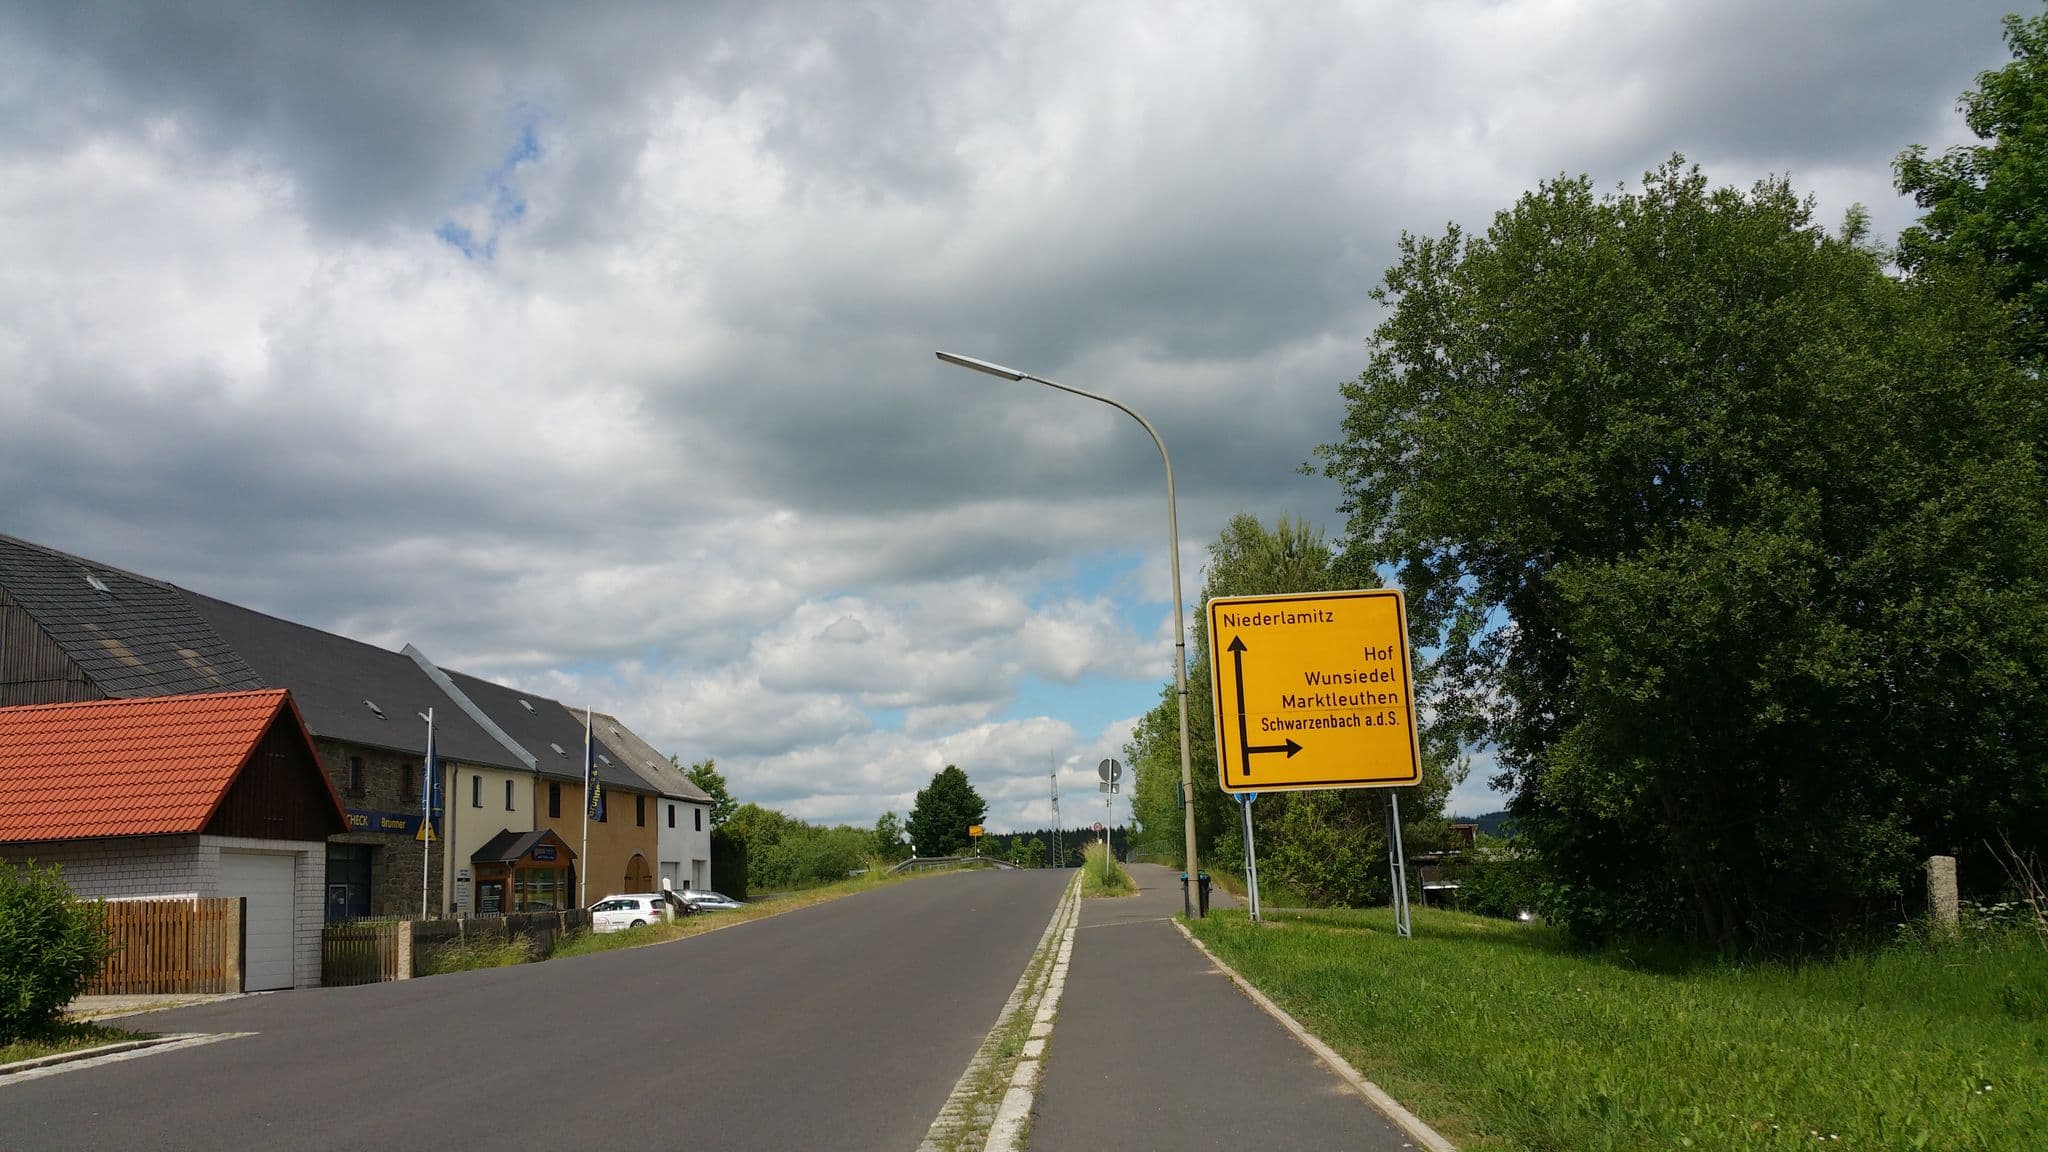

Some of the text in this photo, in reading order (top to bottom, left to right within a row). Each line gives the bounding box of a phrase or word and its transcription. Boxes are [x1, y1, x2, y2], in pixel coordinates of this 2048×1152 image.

[1223, 609, 1334, 628] Niederlamitz
[1364, 645, 1394, 661] Hof
[1304, 667, 1396, 686] Wunsiedel
[1282, 691, 1399, 710] Marktleuthen
[1261, 711, 1400, 732] Schwarzenbach a.d.S.
[381, 817, 406, 829] Brunner
